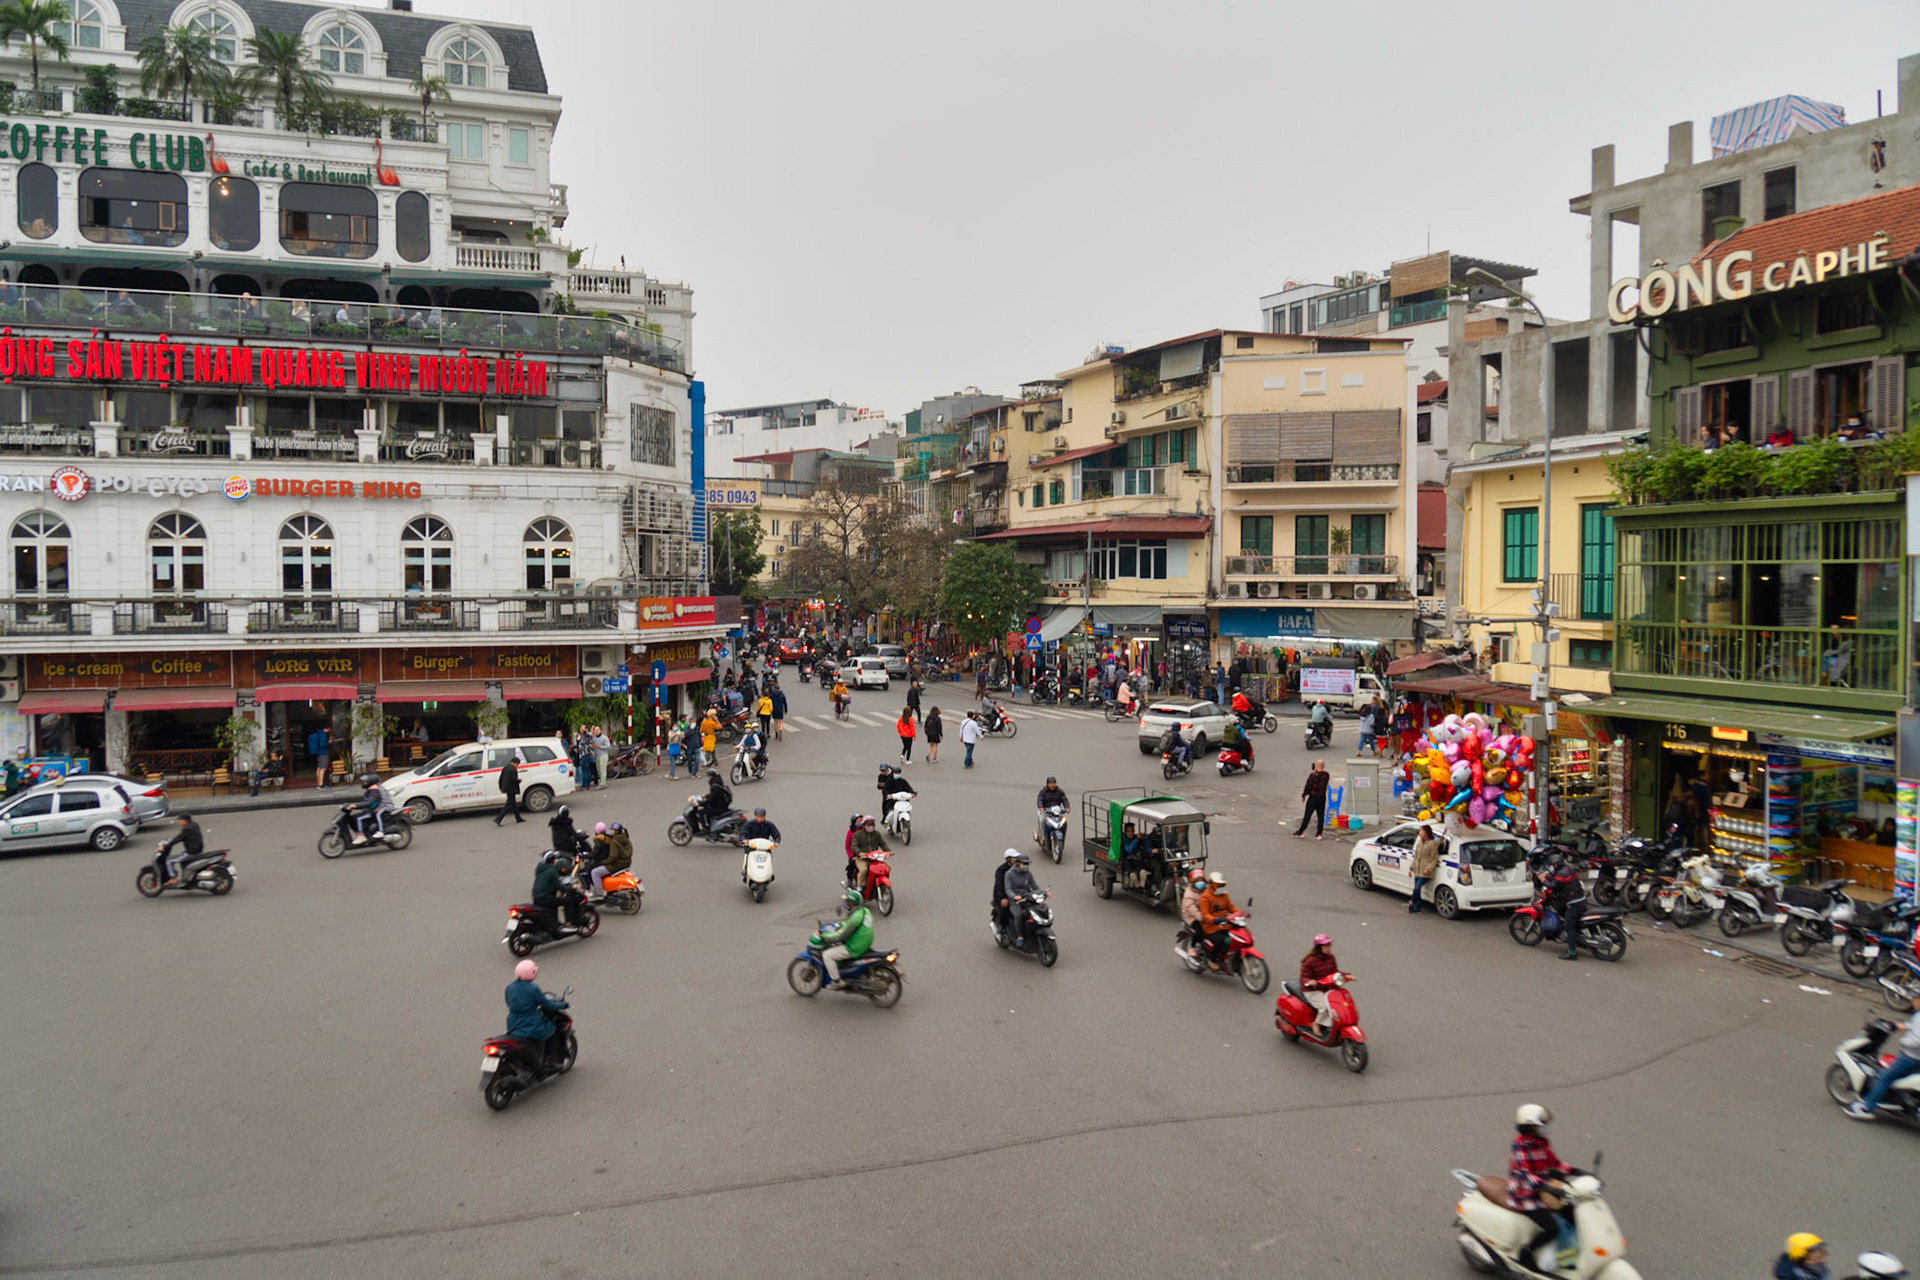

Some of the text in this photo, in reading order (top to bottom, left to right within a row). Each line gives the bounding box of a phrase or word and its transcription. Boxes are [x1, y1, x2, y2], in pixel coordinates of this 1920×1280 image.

[130, 132, 206, 172] CLUB
[243, 159, 373, 185] Café & Restaurant
[66, 327, 122, 379] SẢN
[129, 333, 185, 389] VIỆT
[193, 345, 252, 384] NAM
[260, 347, 345, 389] QUANG
[355, 352, 410, 391] VINH
[418, 347, 487, 394] MUÔN
[495, 350, 547, 397] NĂM
[224, 479, 247, 488] BURGER
[225, 484, 249, 494] KING
[256, 478, 421, 499] BURGER KING
[727, 490, 757, 503] 0943
[497, 653, 551, 668] Fastfood
[650, 648, 675, 662] LONG
[43, 662, 65, 676] Ice
[77, 662, 124, 676] cream
[151, 658, 203, 675] Coffee
[264, 659, 310, 673] LONG
[413, 655, 460, 672] Burger
[1666, 723, 1687, 739] 116
[1804, 740, 1850, 753] BOOKING
[1851, 744, 1888, 758] OFFICE
